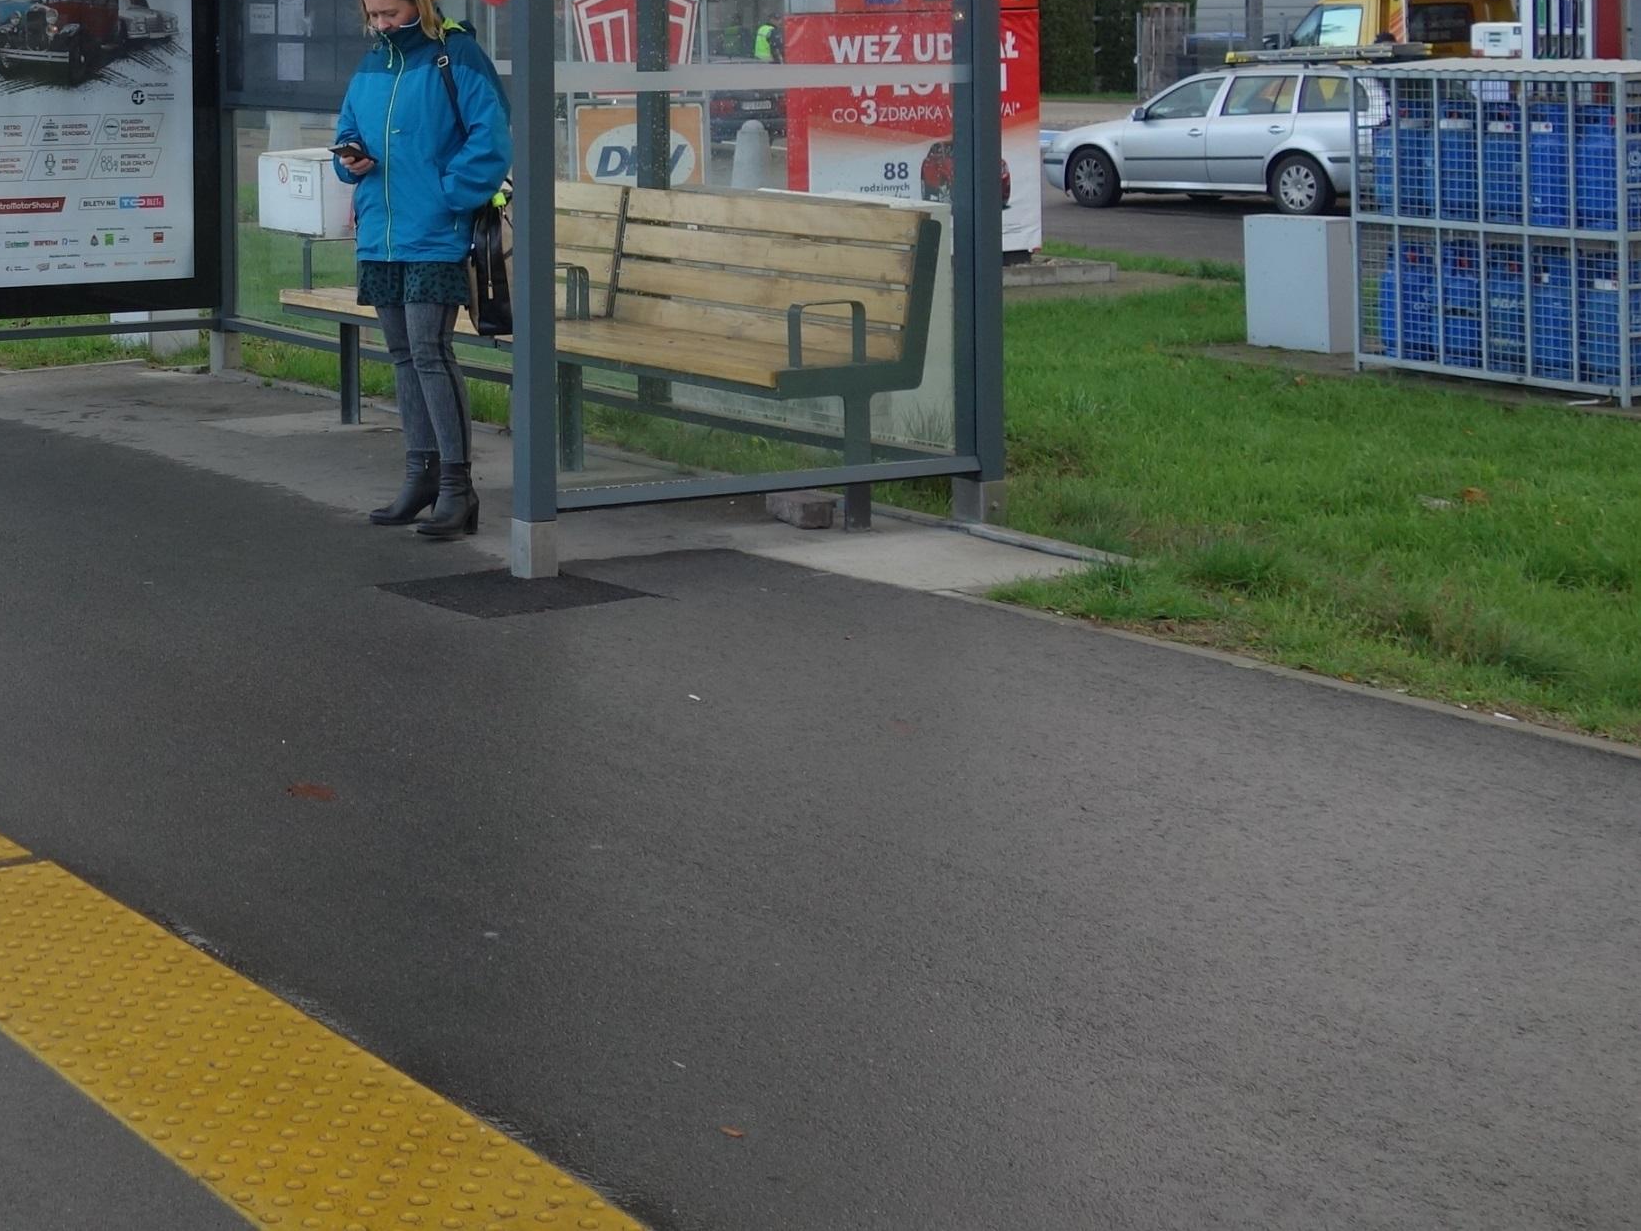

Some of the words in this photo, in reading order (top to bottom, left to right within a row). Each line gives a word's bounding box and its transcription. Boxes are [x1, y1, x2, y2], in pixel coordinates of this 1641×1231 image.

[828, 26, 902, 63] WEŹ
[832, 108, 858, 123] CO
[860, 99, 878, 125] 3
[879, 104, 943, 122] ZDRAPKA
[883, 162, 909, 180] 88
[859, 183, 910, 194] rodzinnych
